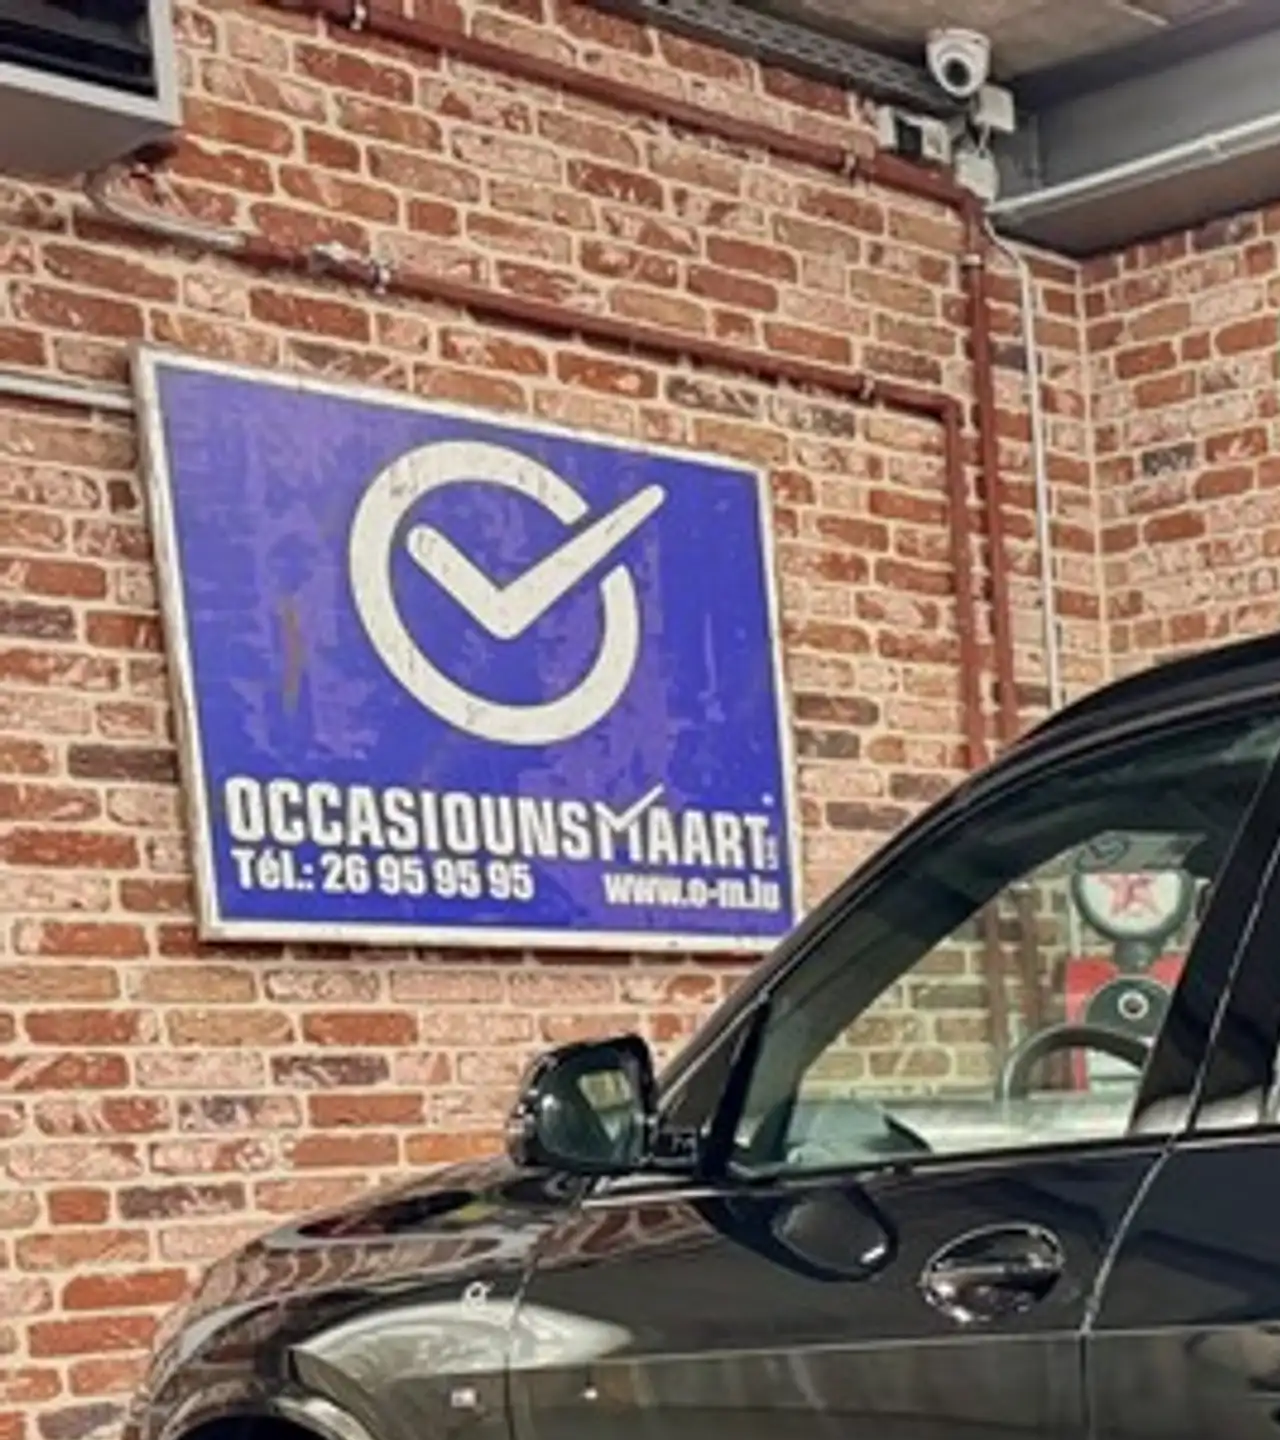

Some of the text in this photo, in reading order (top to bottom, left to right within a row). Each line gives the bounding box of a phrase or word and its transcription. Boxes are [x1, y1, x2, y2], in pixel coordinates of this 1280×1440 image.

[224, 775, 770, 870] OCCASIOUNSMAART
[230, 847, 535, 900] Tél.: 26 95 95 95
